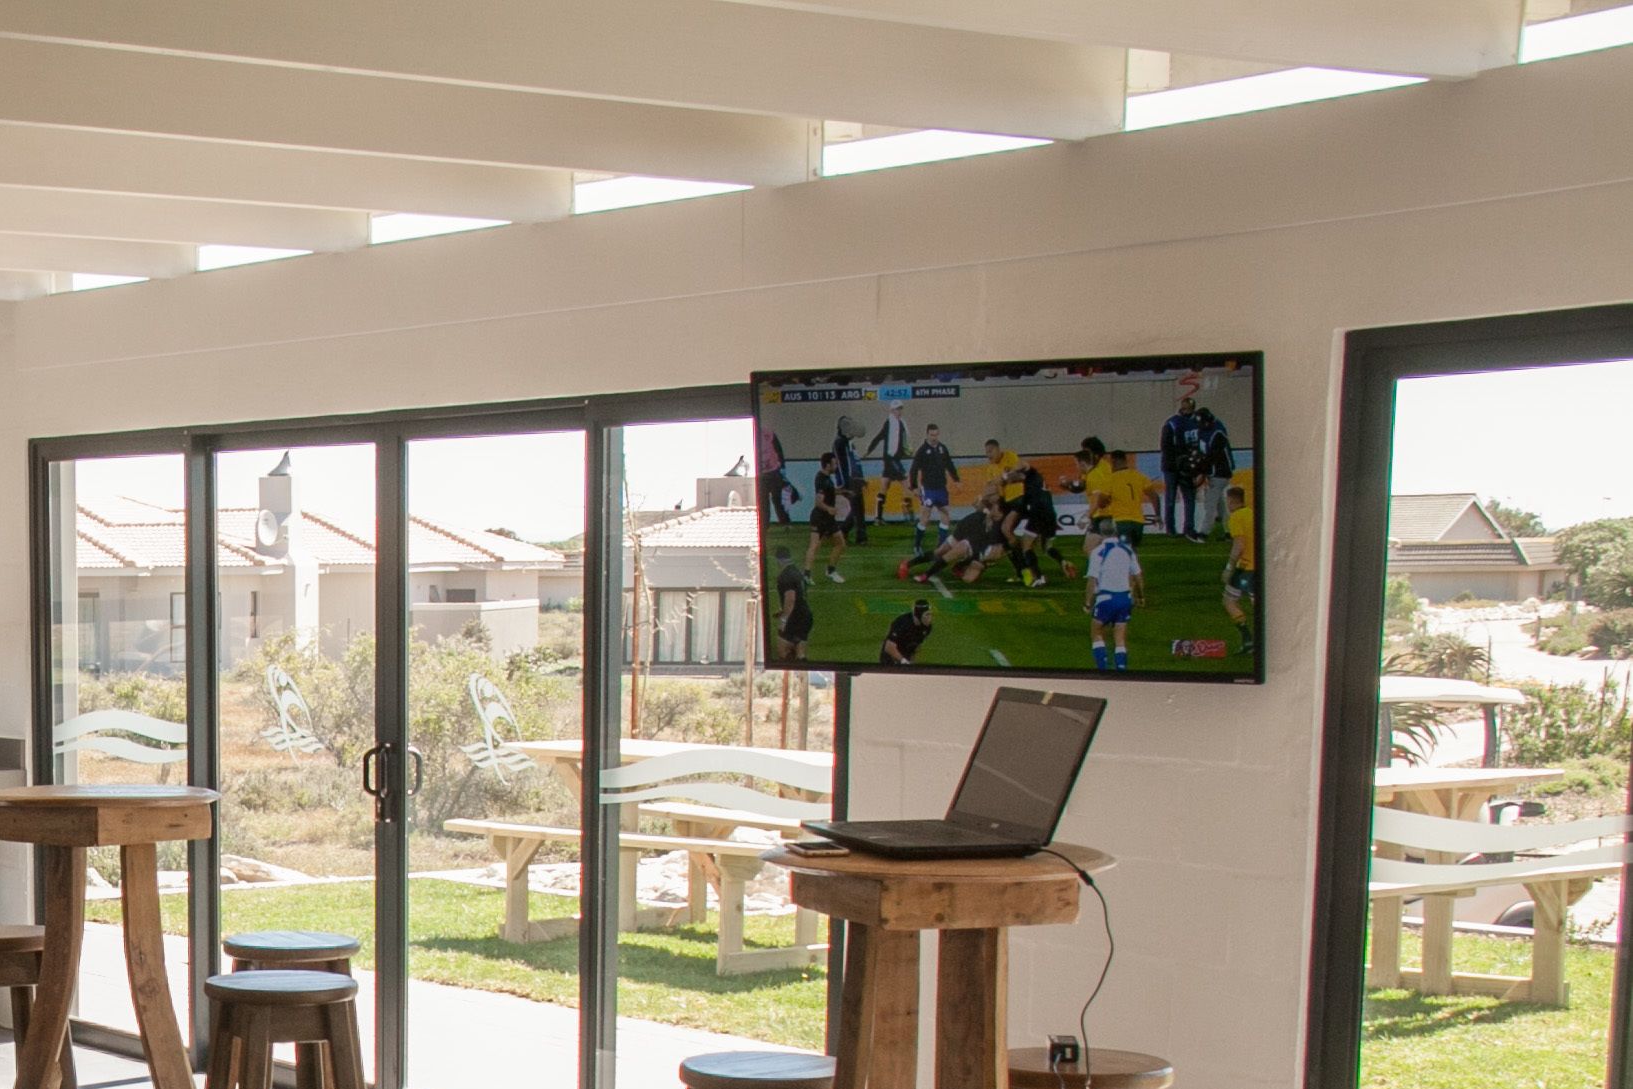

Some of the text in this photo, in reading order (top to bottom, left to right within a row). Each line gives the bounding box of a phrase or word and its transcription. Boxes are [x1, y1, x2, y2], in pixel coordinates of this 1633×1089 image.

[784, 392, 802, 401] AUS
[841, 390, 860, 400] ARG
[931, 387, 956, 396] PHASE
